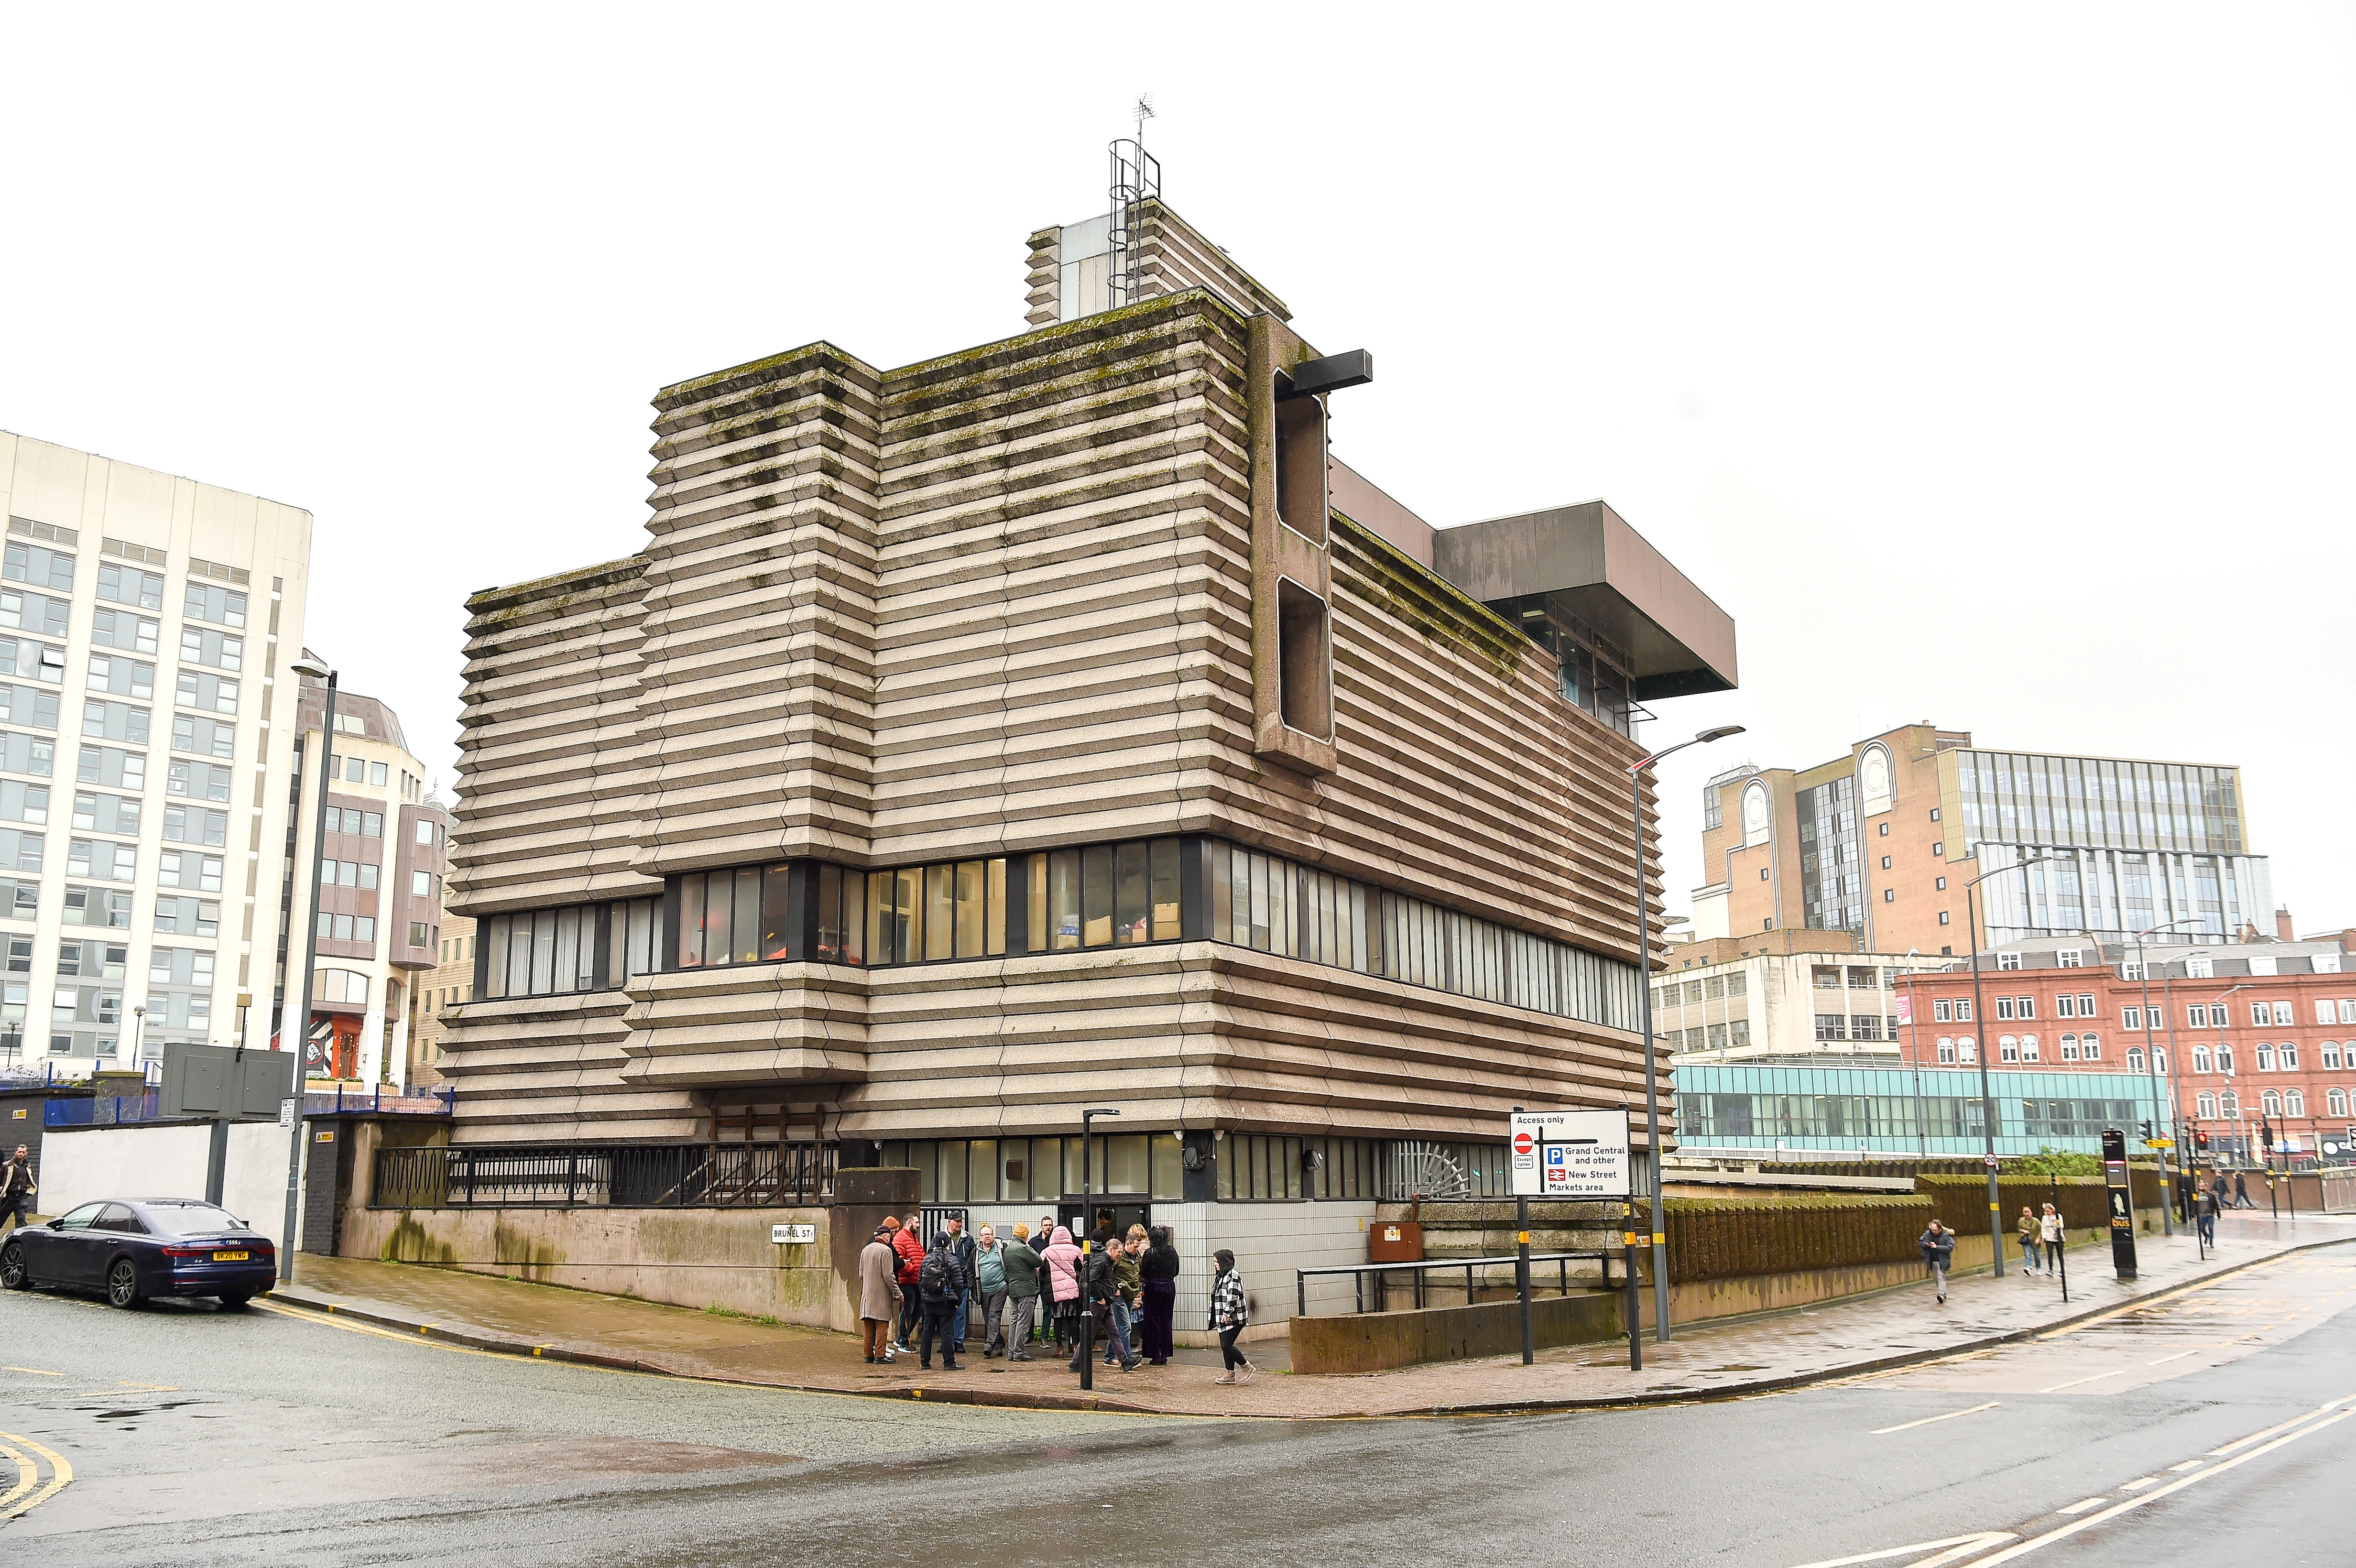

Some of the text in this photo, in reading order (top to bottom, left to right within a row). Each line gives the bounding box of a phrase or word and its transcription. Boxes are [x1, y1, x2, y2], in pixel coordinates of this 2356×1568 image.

[1548, 1116, 1564, 1124] only
[1551, 1150, 1561, 1163] P
[2112, 1218, 2130, 1227] bus
